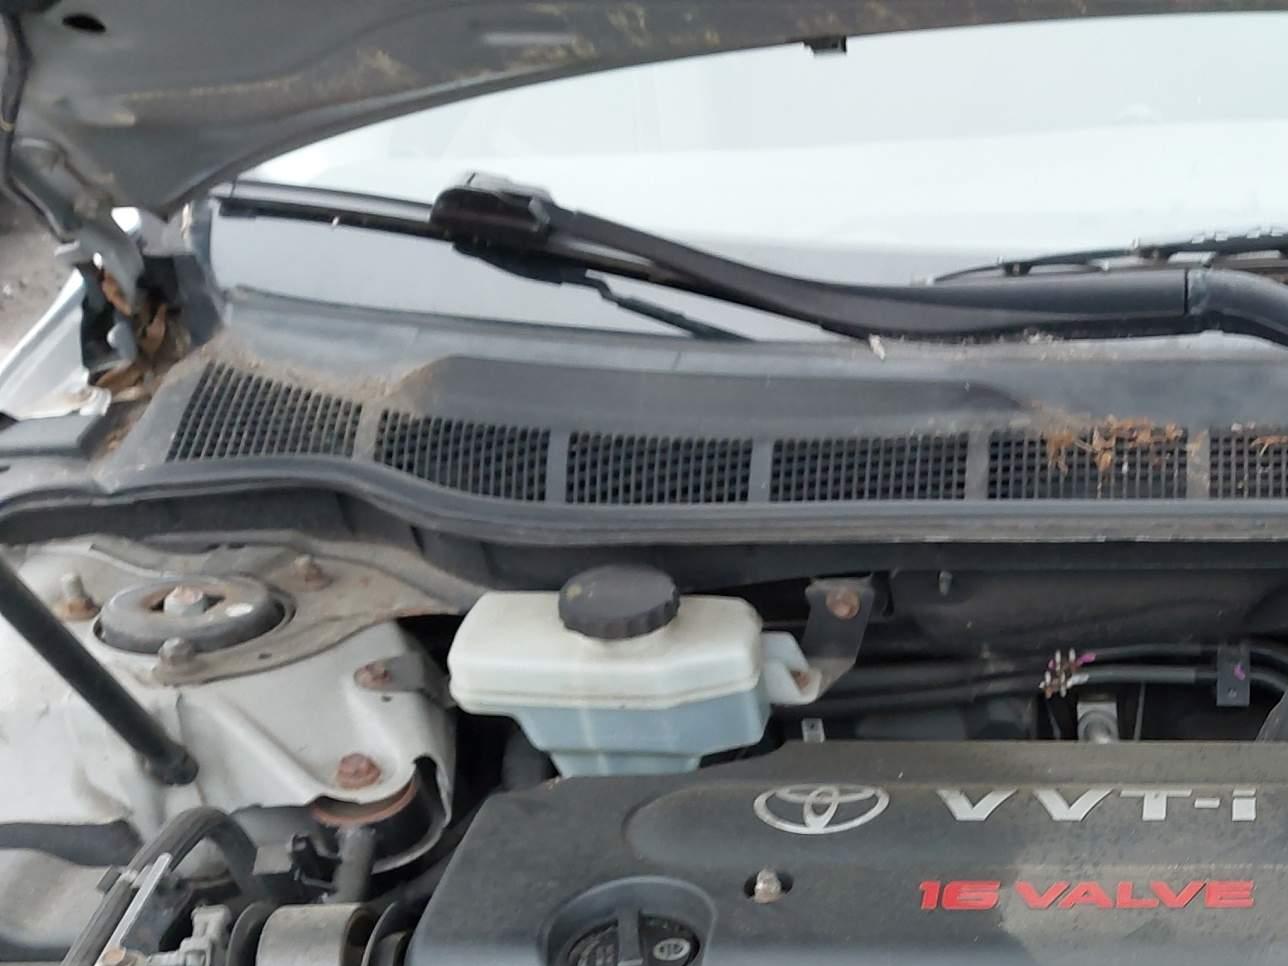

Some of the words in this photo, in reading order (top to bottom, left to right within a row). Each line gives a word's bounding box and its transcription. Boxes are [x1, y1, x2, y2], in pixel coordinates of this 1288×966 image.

[936, 788, 1256, 821] VVT-i
[919, 880, 1000, 910] 16
[1014, 880, 1256, 909] VALVE
